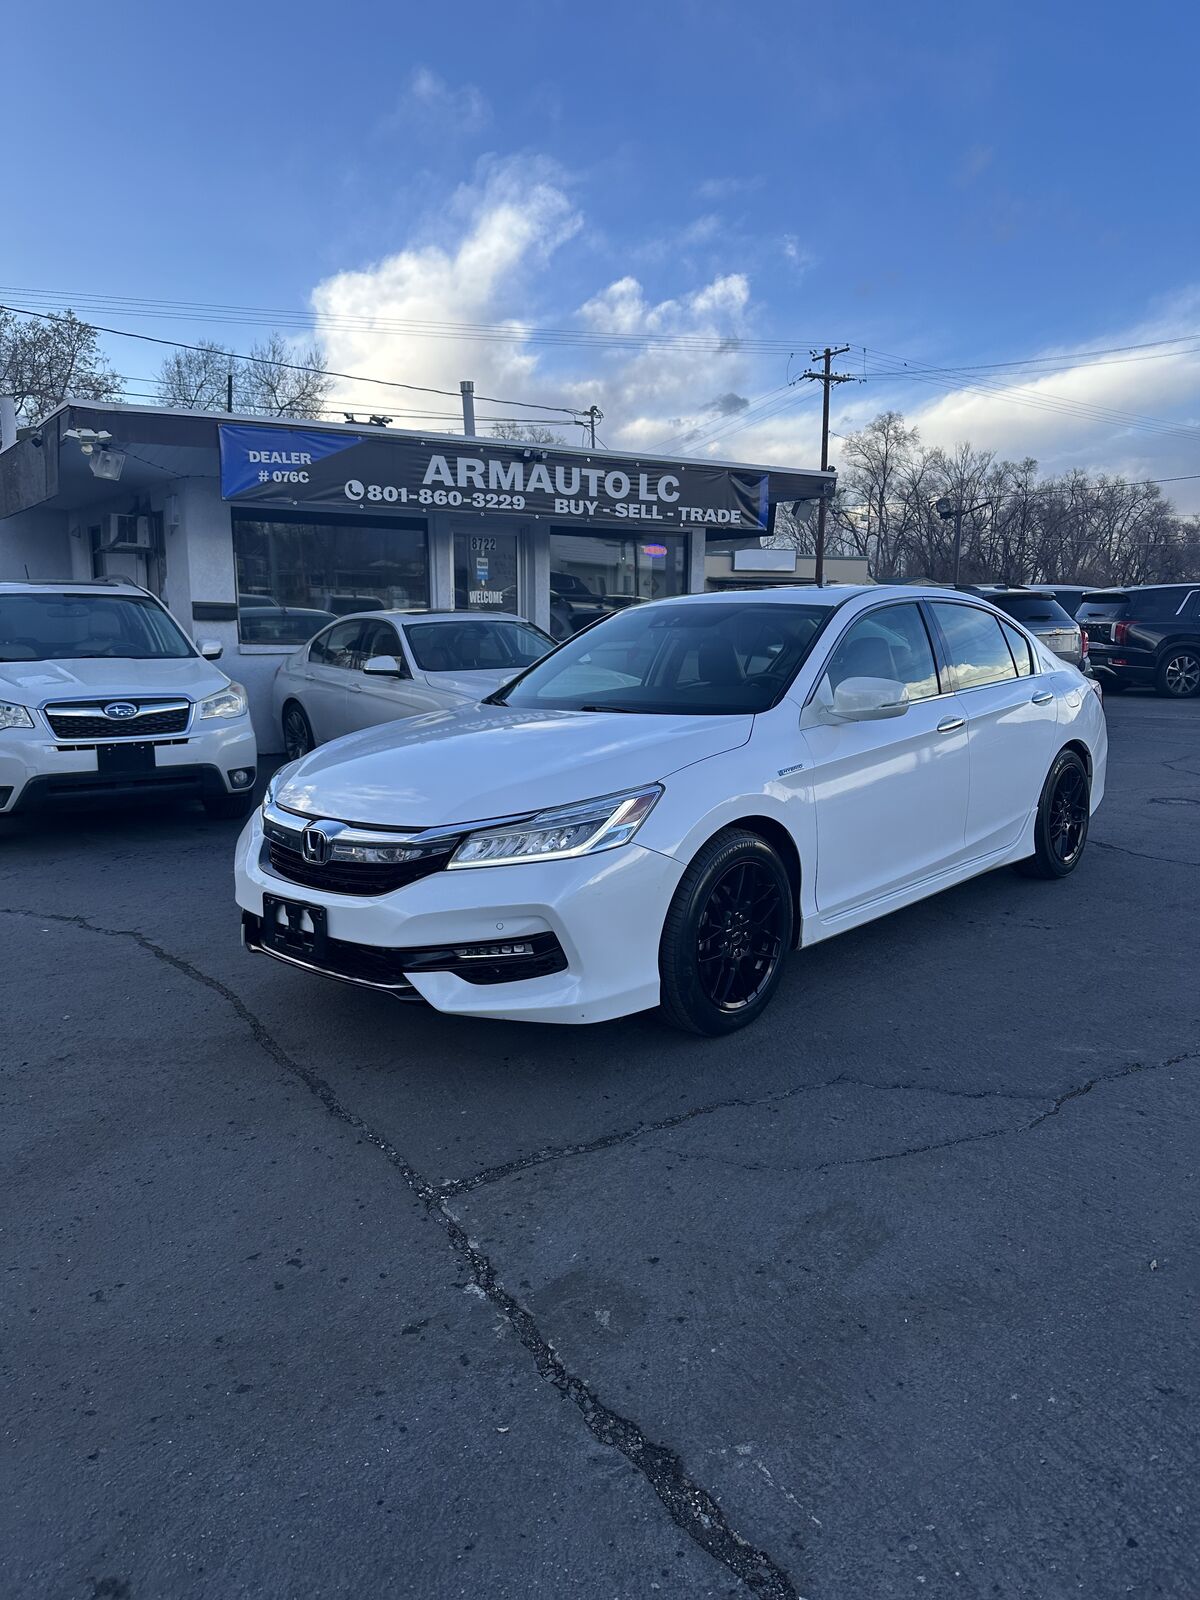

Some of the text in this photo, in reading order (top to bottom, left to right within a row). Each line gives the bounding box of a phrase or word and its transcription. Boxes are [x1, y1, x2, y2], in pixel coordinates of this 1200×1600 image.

[249, 450, 312, 465] DEALER
[258, 470, 310, 484] # 076C
[367, 484, 526, 510] 801-860-3229
[554, 498, 599, 515] BUY
[615, 502, 663, 520] SELL
[678, 506, 742, 524] TRADE
[471, 537, 496, 550] 8722
[469, 590, 503, 604] WELCOME
